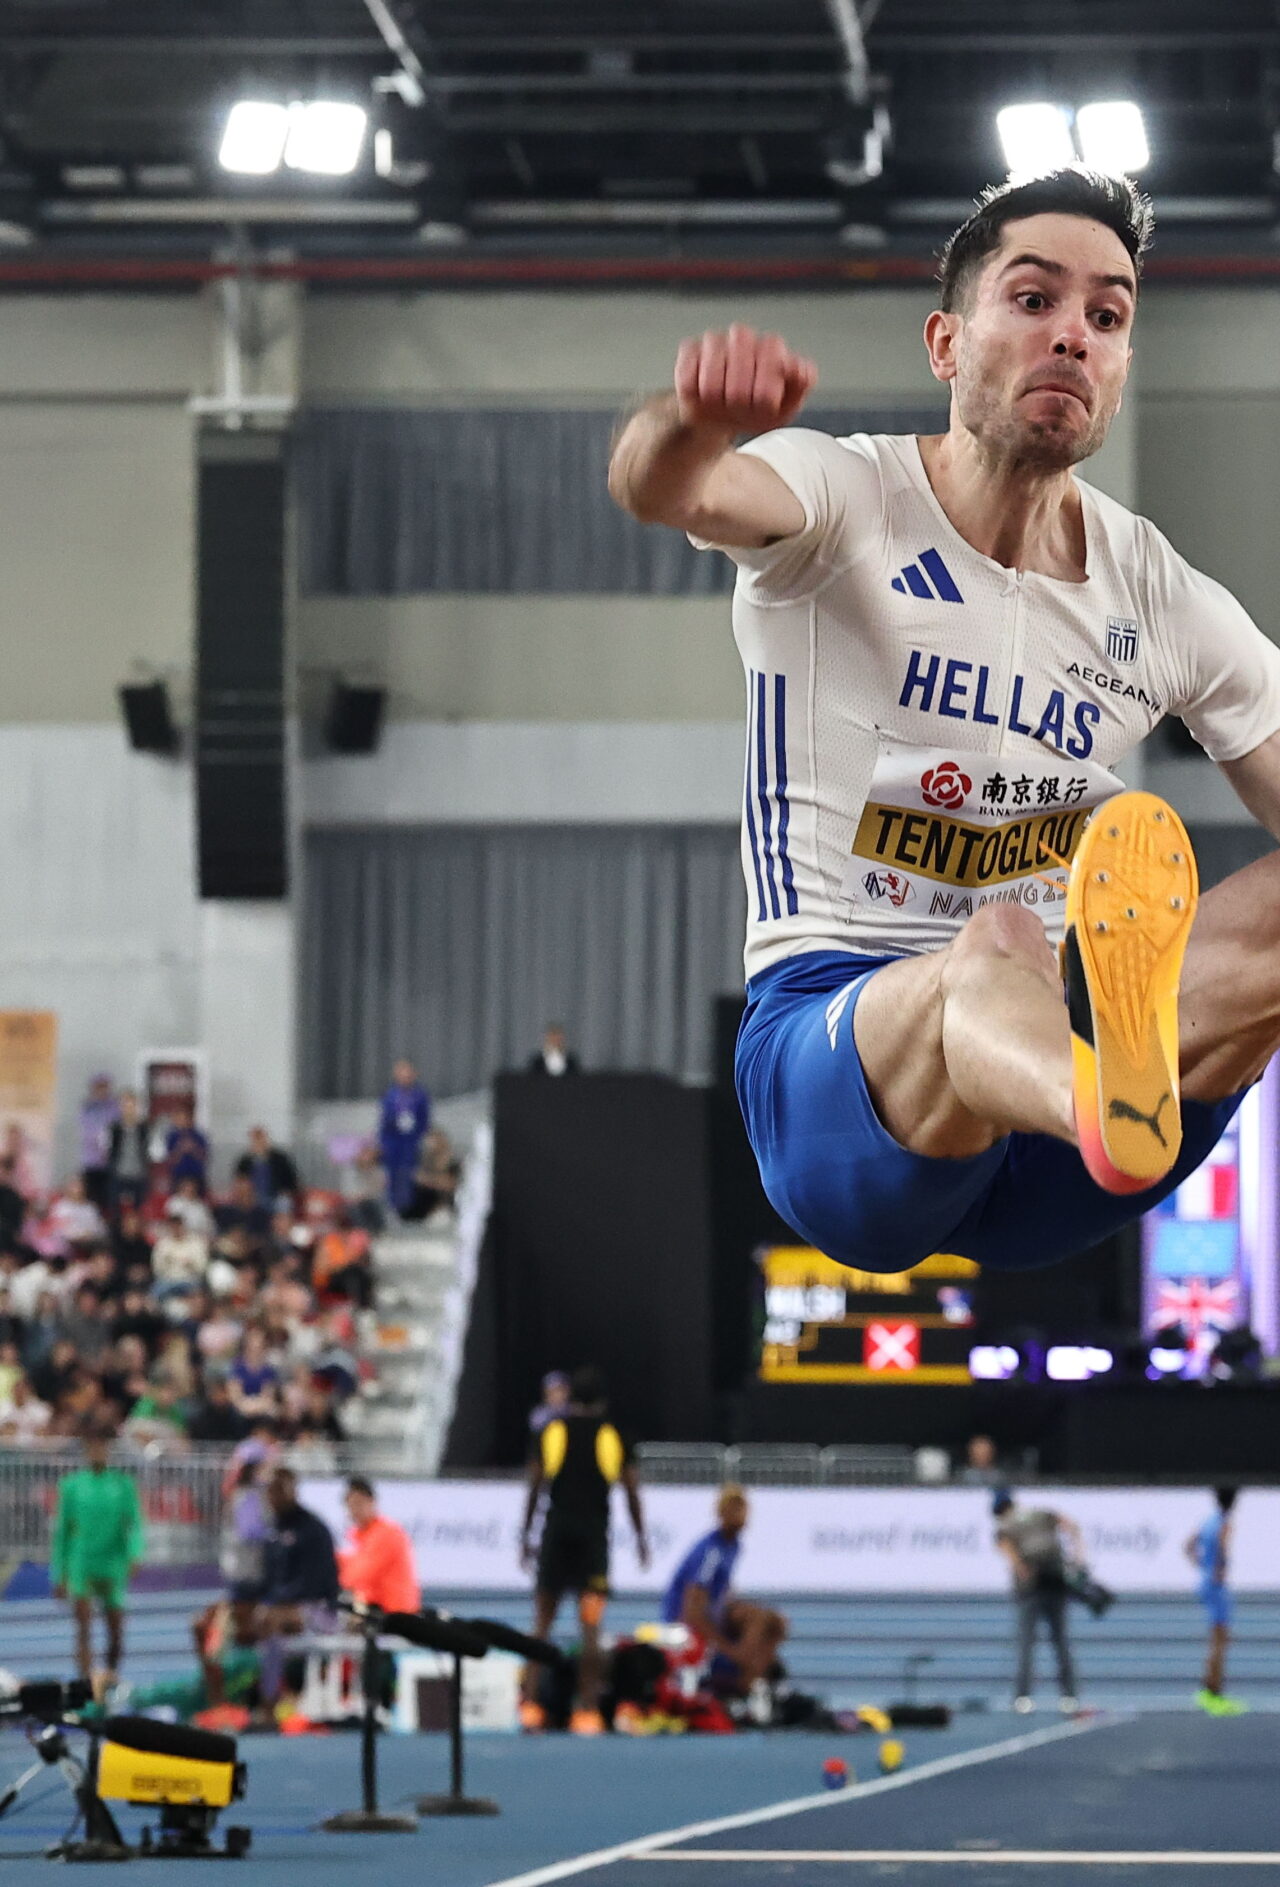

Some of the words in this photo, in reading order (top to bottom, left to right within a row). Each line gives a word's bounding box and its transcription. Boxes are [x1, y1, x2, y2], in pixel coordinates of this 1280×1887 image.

[899, 650, 1099, 759] HELLAS
[1066, 662, 1151, 706] AEGEAN
[875, 809, 1081, 881] TENTOGLOU
